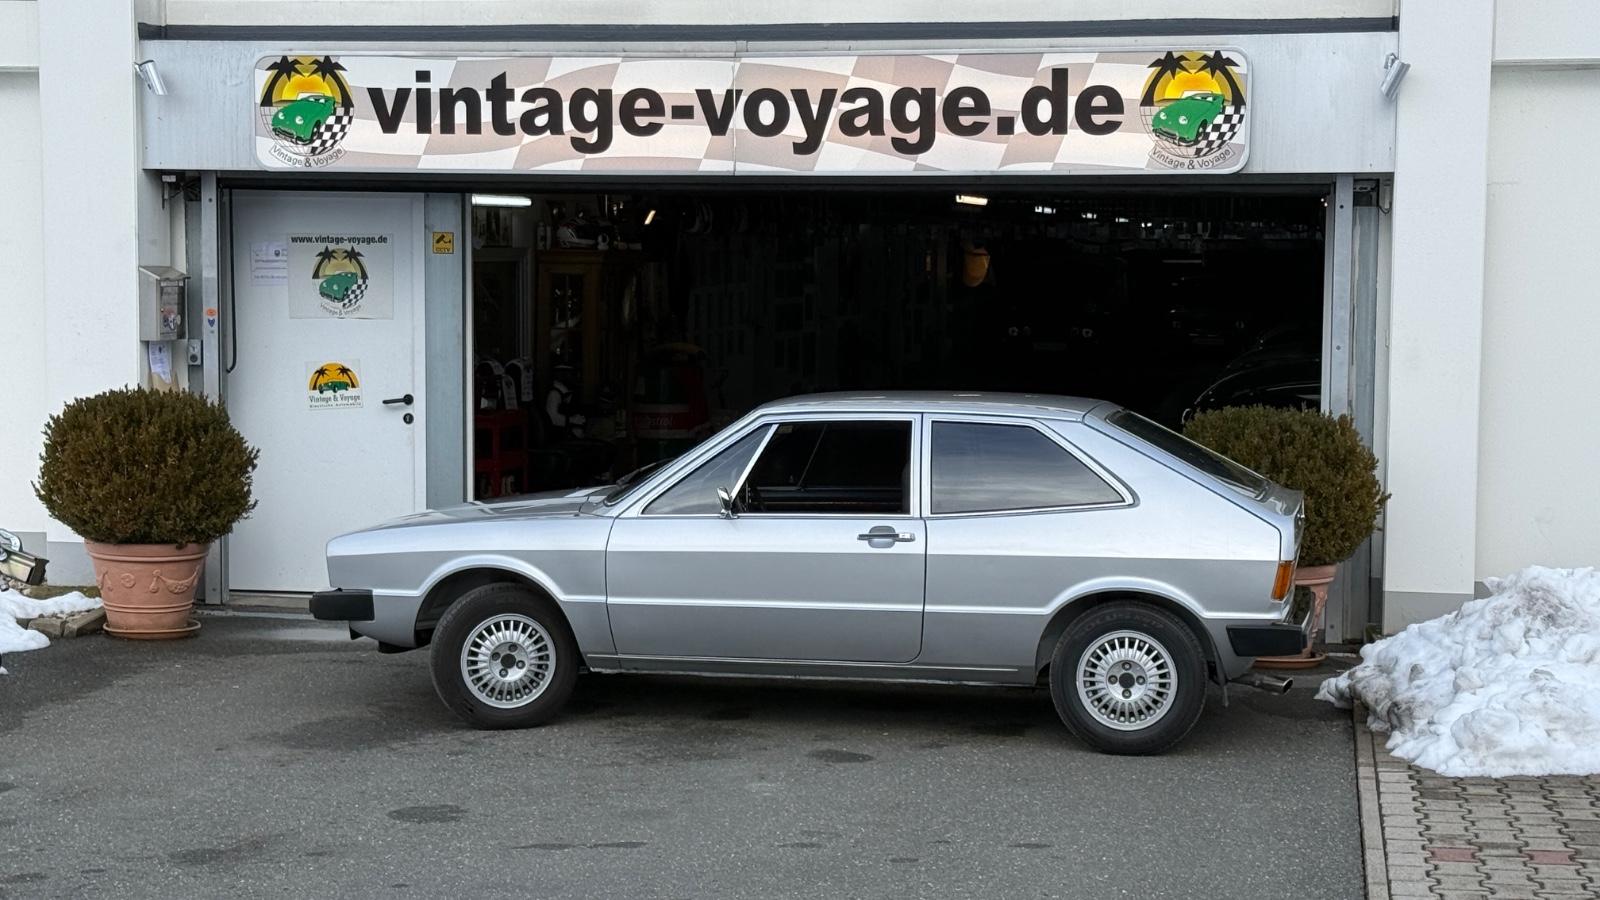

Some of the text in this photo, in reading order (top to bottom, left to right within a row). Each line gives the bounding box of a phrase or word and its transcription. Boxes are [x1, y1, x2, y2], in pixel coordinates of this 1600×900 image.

[367, 68, 1124, 155] vintage-voyage.de
[273, 145, 342, 168] Vintage & Voyage
[1153, 147, 1231, 170] Vintage & Voyage
[291, 235, 388, 245] www.vintage-voyage.de
[309, 395, 331, 403] Vintage
[340, 394, 361, 402] Voyage
